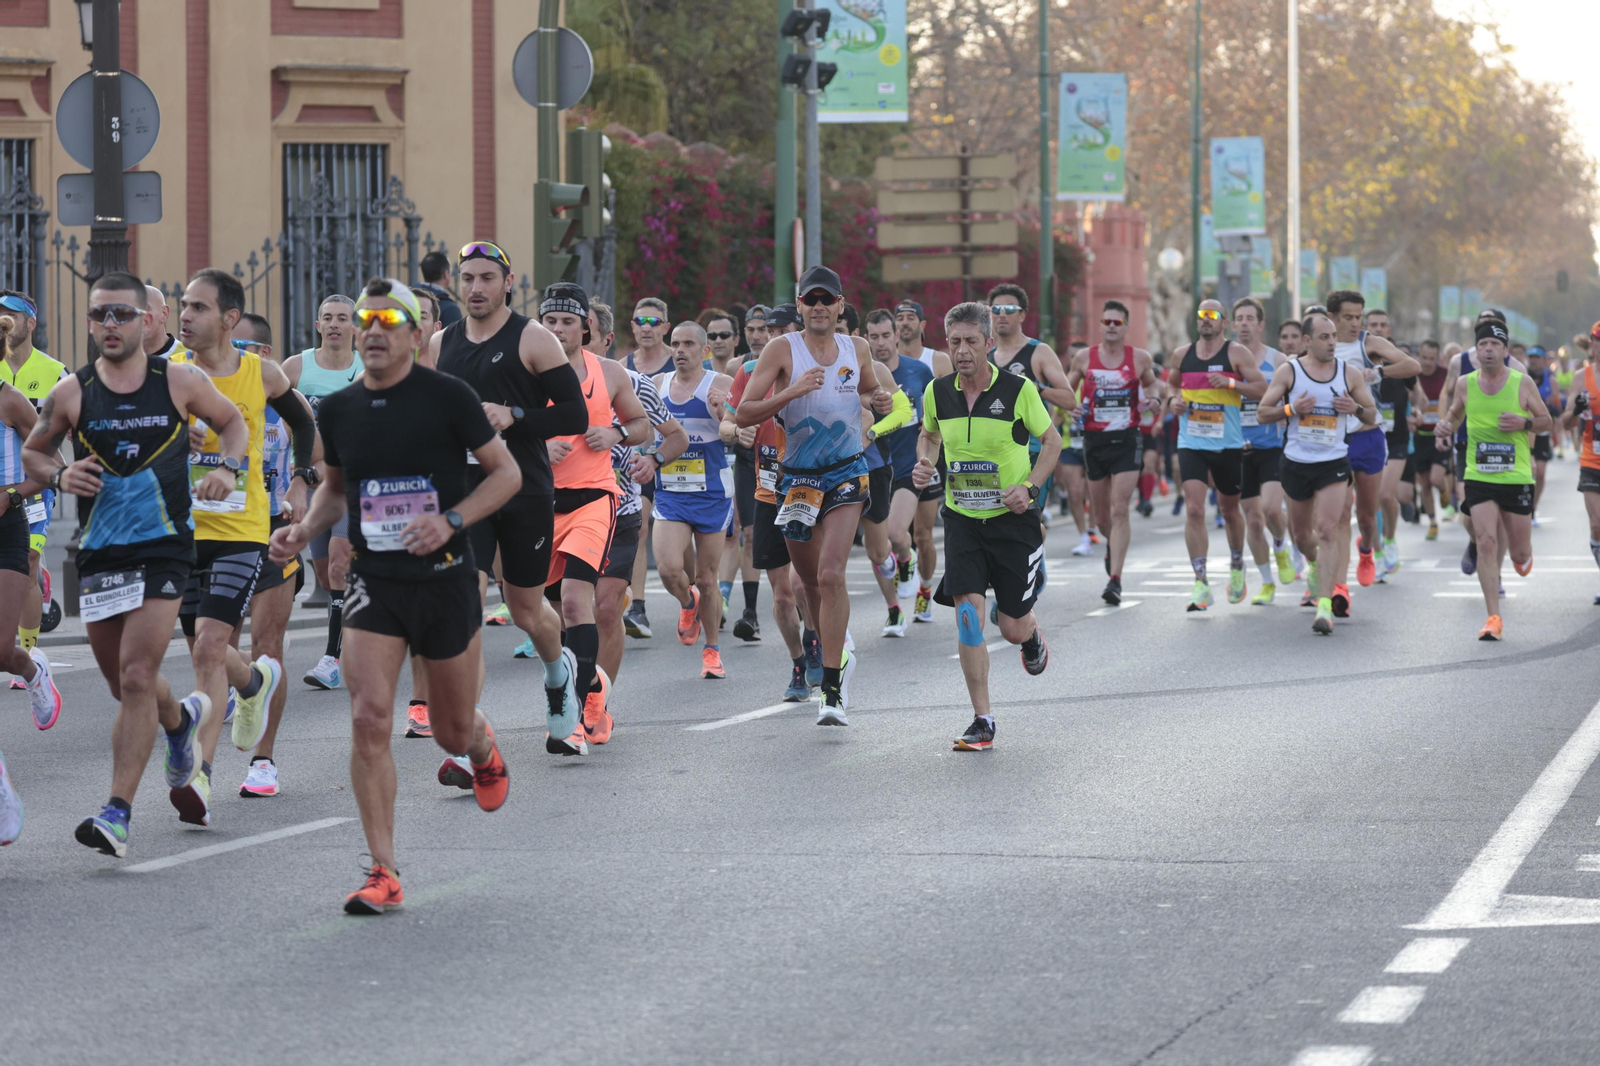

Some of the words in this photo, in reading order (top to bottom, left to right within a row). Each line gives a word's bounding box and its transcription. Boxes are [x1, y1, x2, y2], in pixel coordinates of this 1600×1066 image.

[1199, 403, 1221, 411] ZURICH
[1312, 407, 1336, 415] ZURICH
[1487, 444, 1512, 452] ZURICH
[962, 463, 993, 471] ZURICH
[382, 480, 428, 493] ZURICH
[792, 477, 821, 488] ZURICH
[965, 479, 983, 487] 1330
[973, 490, 1001, 498] OLIVEIRA
[385, 503, 411, 516] 6067
[101, 573, 124, 588] 2746
[84, 597, 94, 605] EL
